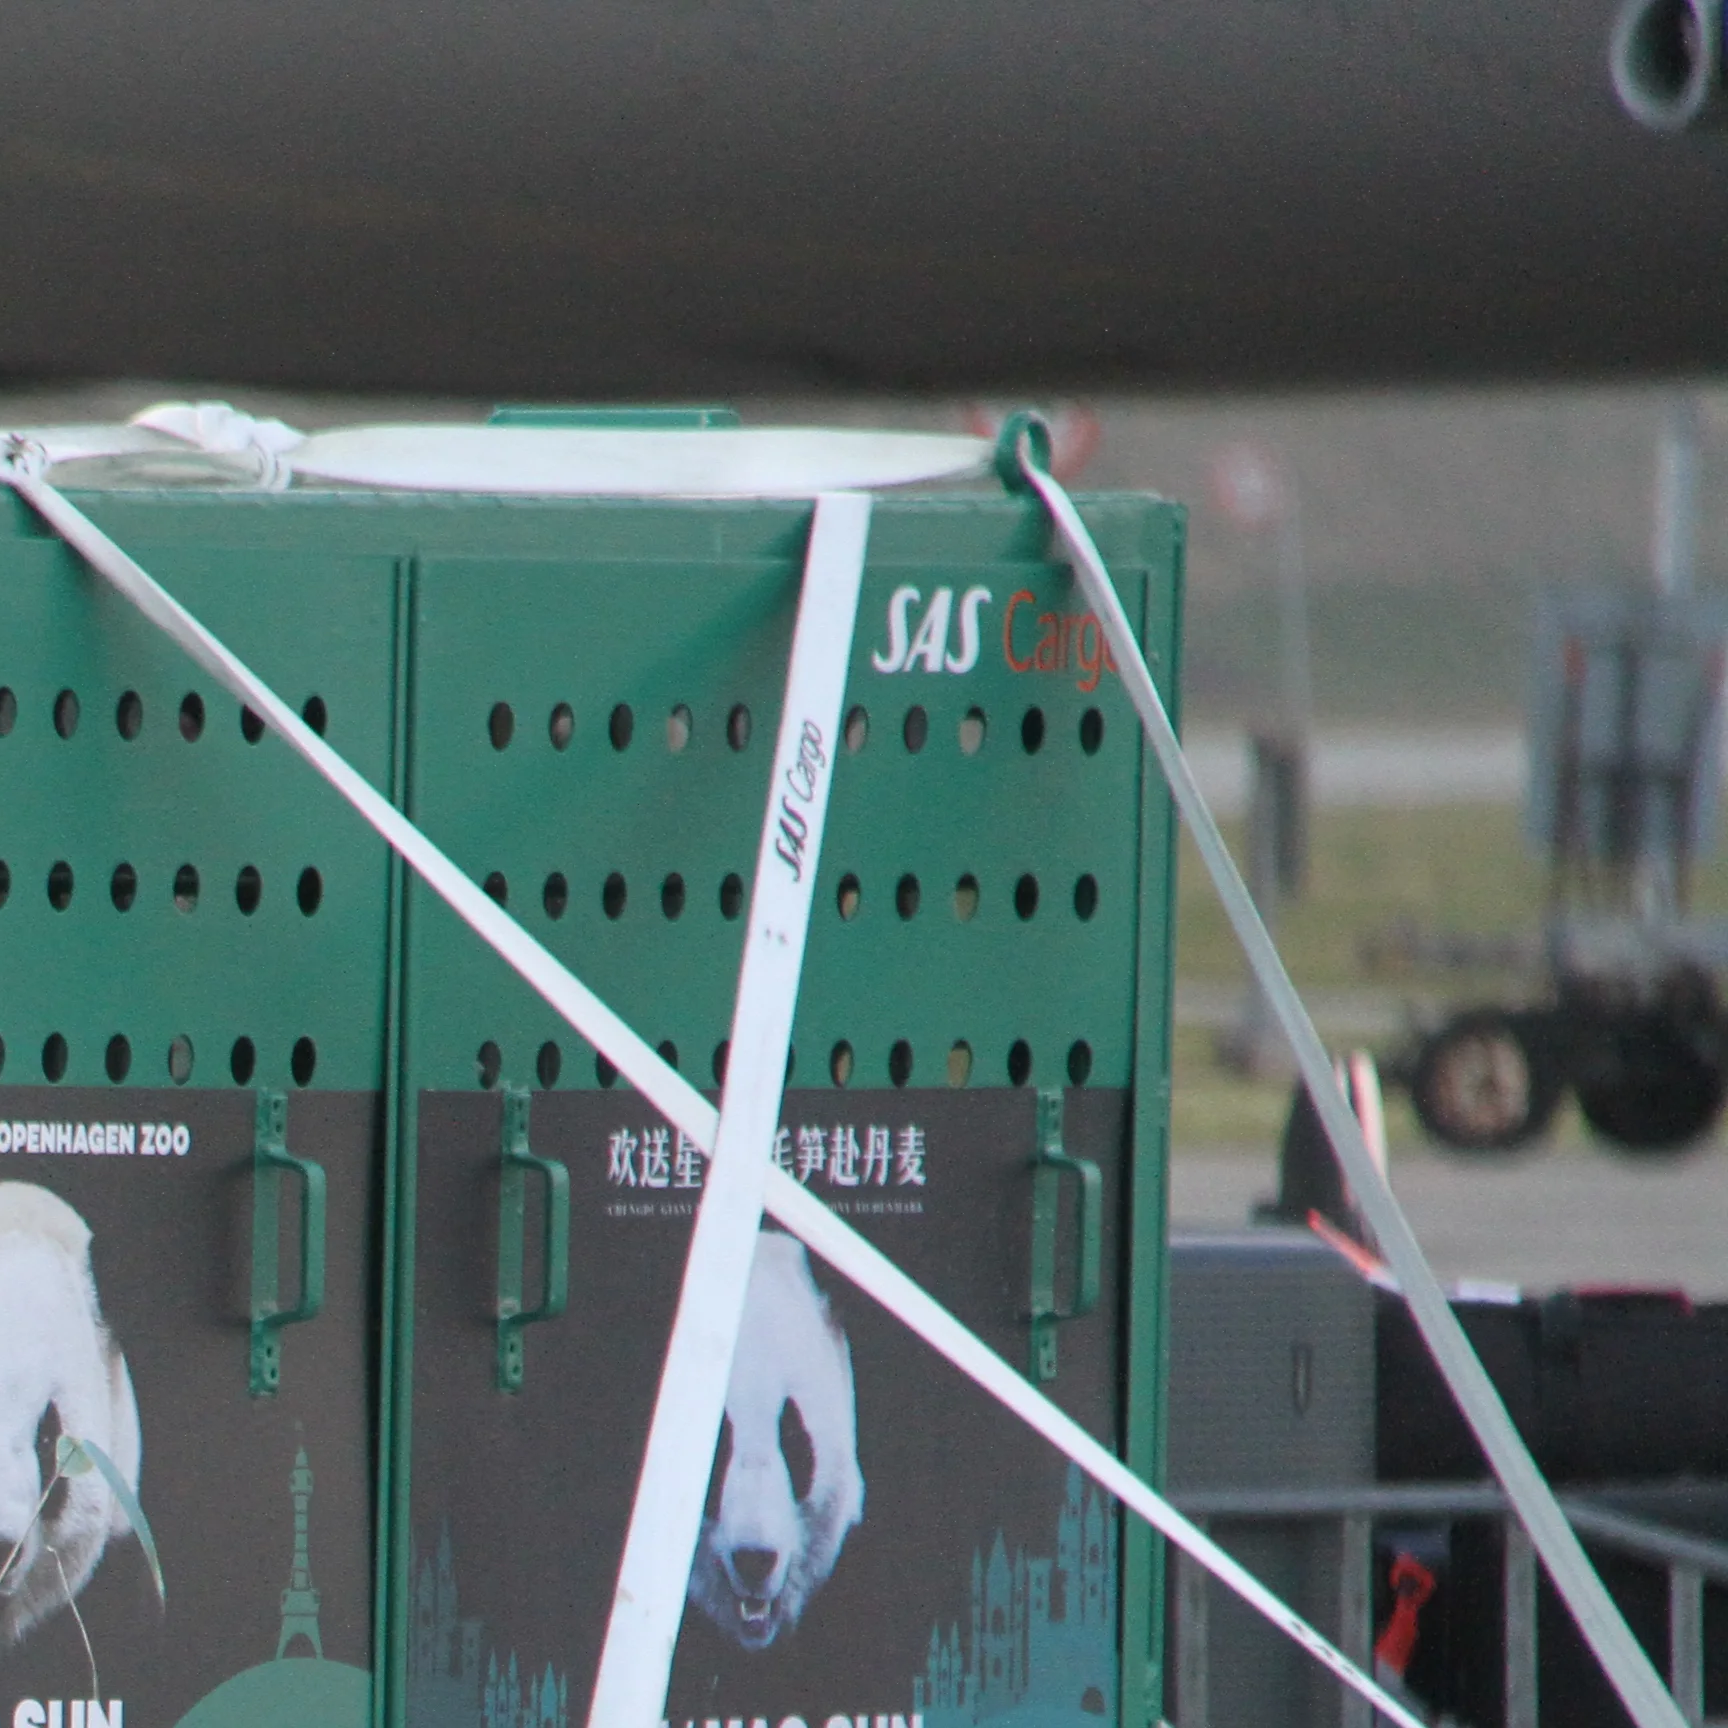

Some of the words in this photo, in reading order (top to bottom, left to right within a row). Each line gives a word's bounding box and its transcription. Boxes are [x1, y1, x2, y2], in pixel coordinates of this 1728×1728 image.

[872, 585, 992, 674] SAS
[786, 719, 827, 804] Cargo
[773, 796, 816, 883] SAS
[141, 1123, 191, 1156] ZOO
